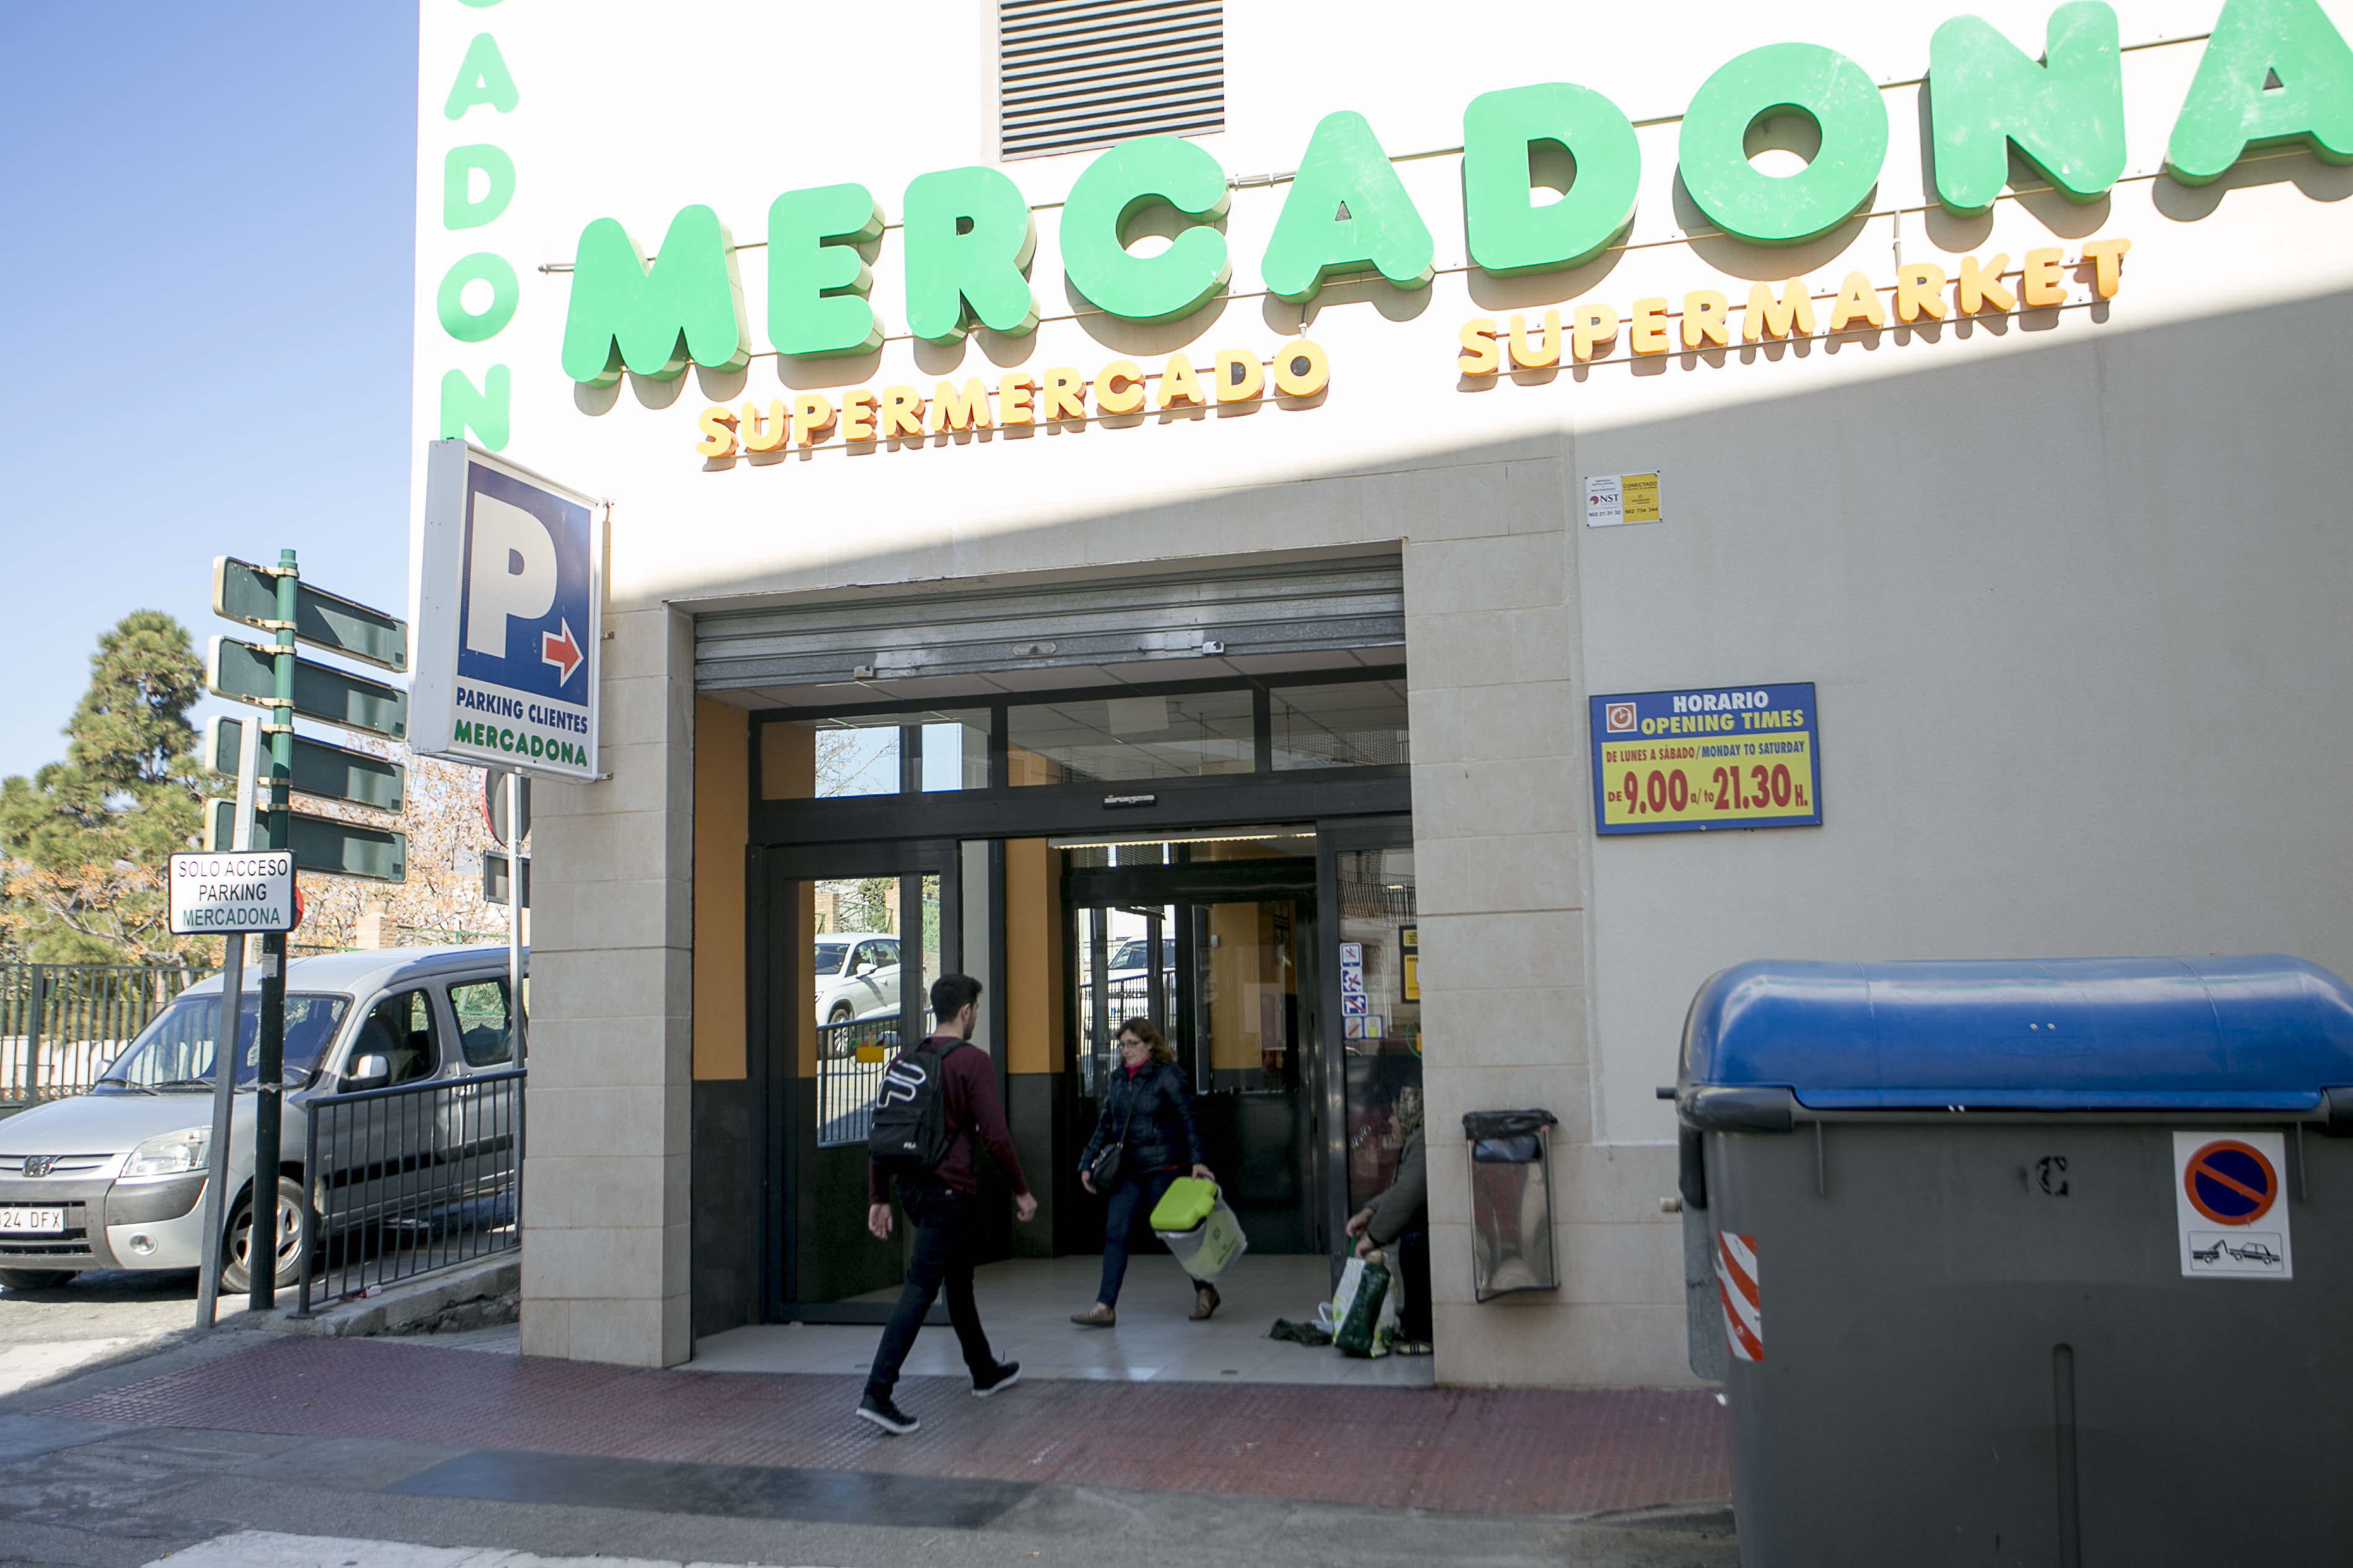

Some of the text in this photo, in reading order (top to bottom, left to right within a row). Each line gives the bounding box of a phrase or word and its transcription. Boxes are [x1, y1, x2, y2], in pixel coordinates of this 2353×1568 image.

[561, 0, 2353, 386] MERCADONA
[437, 0, 520, 453] ADON
[1457, 238, 2131, 376] SUPERMARKET
[696, 339, 1329, 457] SUPERMERCADO
[1600, 494, 1620, 503] NST
[466, 490, 557, 659] P
[456, 687, 588, 734] PARKING CLIENTES
[1673, 690, 1769, 713] HORARIO
[1640, 709, 1804, 735] OPENING TIMES
[455, 718, 588, 768] MERCADONA
[1606, 751, 1617, 763] DE
[1620, 749, 1647, 762] LUNES
[1650, 748, 1656, 761] A
[1744, 743, 1755, 756] TO
[1758, 740, 1806, 755] SATURDAY
[1607, 791, 1622, 802] DE
[1624, 769, 1689, 815] 9.00
[1713, 763, 1791, 810] 21.30
[179, 859, 288, 877] SOLO ACCESO
[199, 883, 267, 901] PARKING
[183, 907, 281, 927] MERCADONA
[0, 1211, 60, 1228] 24 DFX
